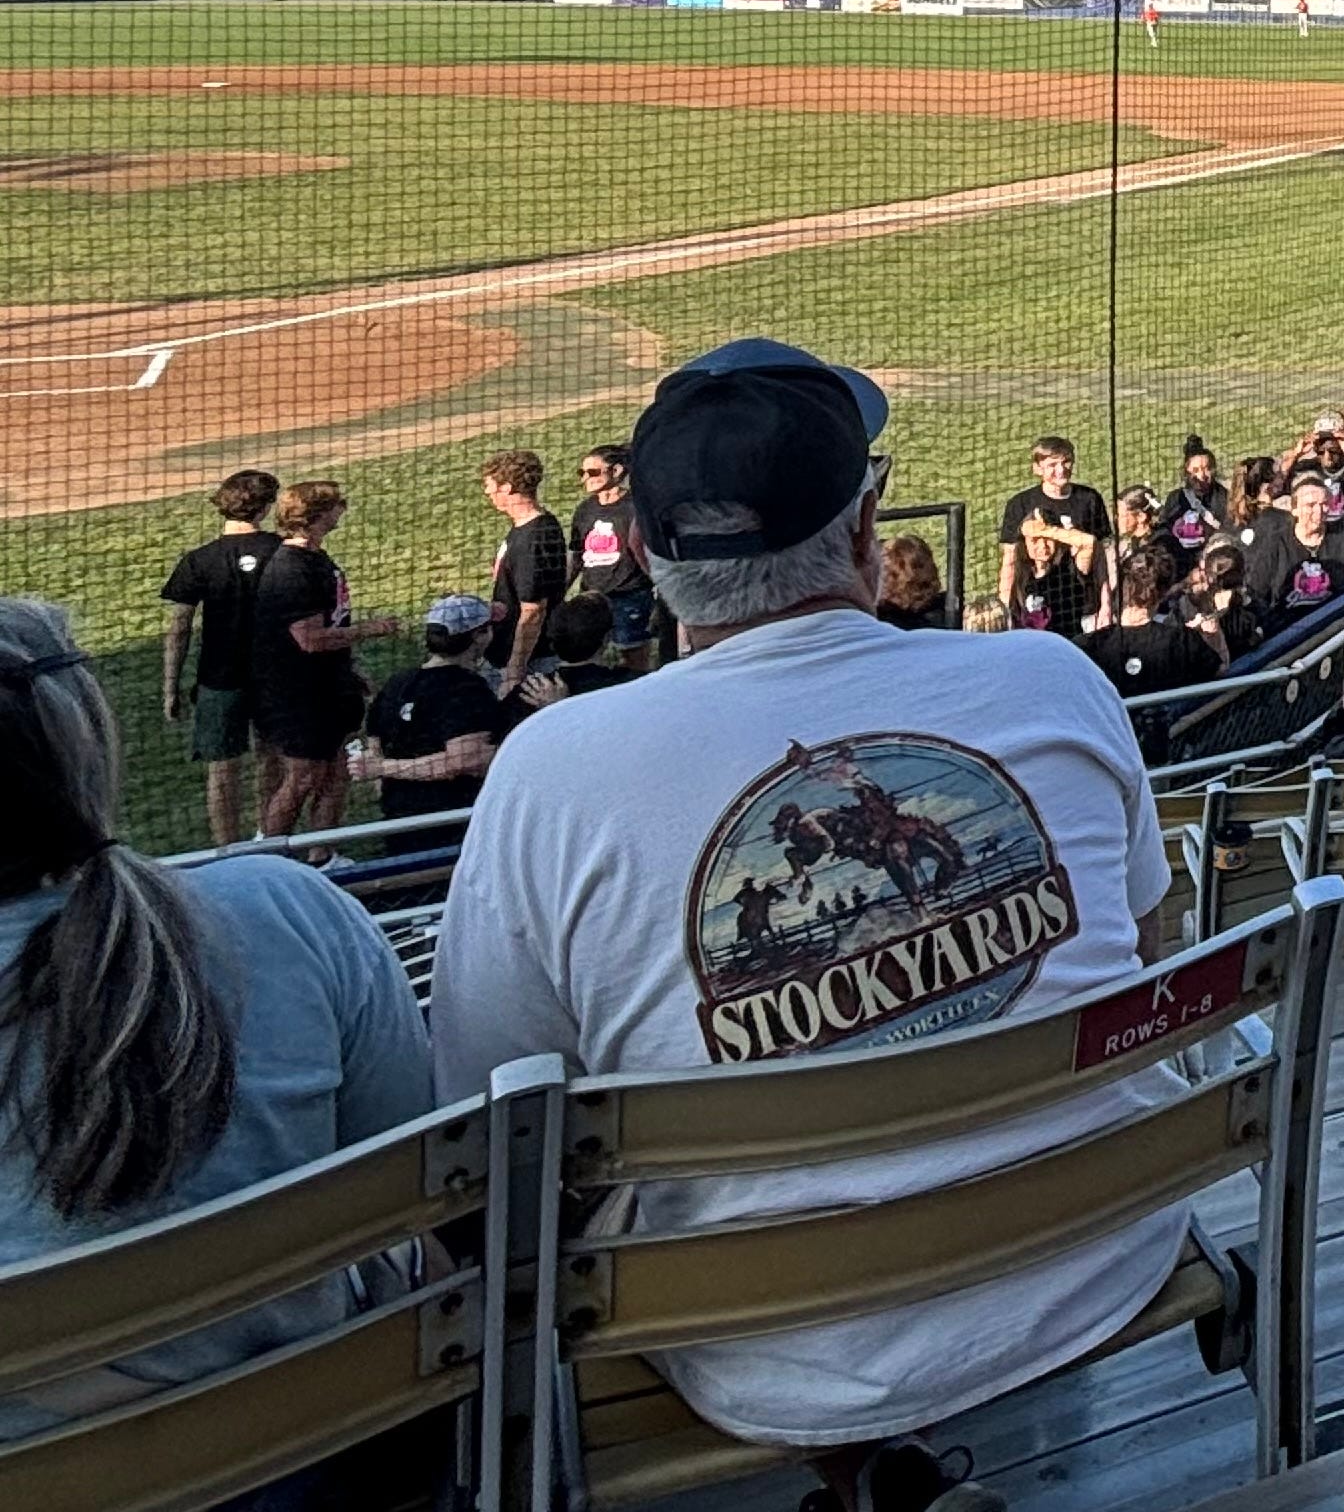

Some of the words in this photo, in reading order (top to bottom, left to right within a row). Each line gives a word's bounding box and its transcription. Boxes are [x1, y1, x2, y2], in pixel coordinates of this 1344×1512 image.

[712, 875, 1069, 1065] STOCKYARDS
[1151, 969, 1177, 1012] K
[1104, 1013, 1169, 1057] ROWS
[1180, 992, 1213, 1024] 1-8
